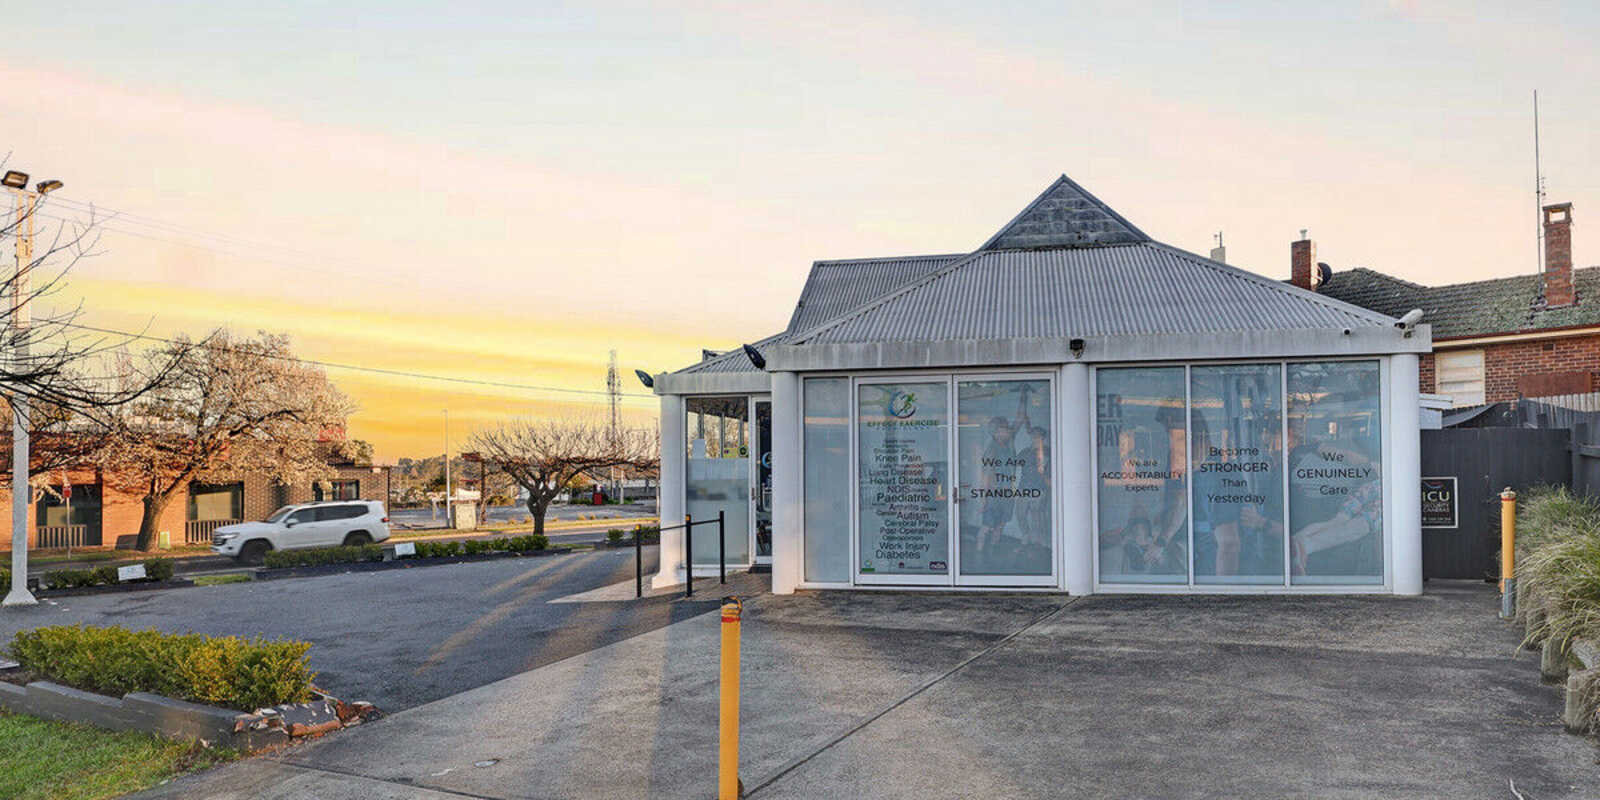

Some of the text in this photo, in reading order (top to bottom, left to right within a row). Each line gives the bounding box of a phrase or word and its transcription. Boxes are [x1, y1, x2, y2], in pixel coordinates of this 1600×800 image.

[1209, 447, 1260, 457] Become
[1322, 452, 1344, 462] We
[901, 454, 922, 462] Pain
[982, 457, 1026, 467] We Are
[1200, 462, 1269, 473] STRONGER
[995, 473, 1017, 482] The
[1102, 471, 1182, 480] ACCOUNTABILITY
[1296, 468, 1372, 479] GENUINELY
[870, 477, 938, 485] Heart Disease
[1222, 478, 1247, 488] Than
[970, 488, 1041, 499] STANDARD
[1125, 484, 1160, 494] Experts
[1319, 485, 1348, 496] Care
[877, 492, 931, 502] Paediatric
[1207, 493, 1266, 505] Yesterday
[1422, 491, 1450, 502] ICU
[896, 511, 929, 519] Autism
[879, 542, 931, 552] Work Injury
[875, 549, 921, 559] Diabetes
